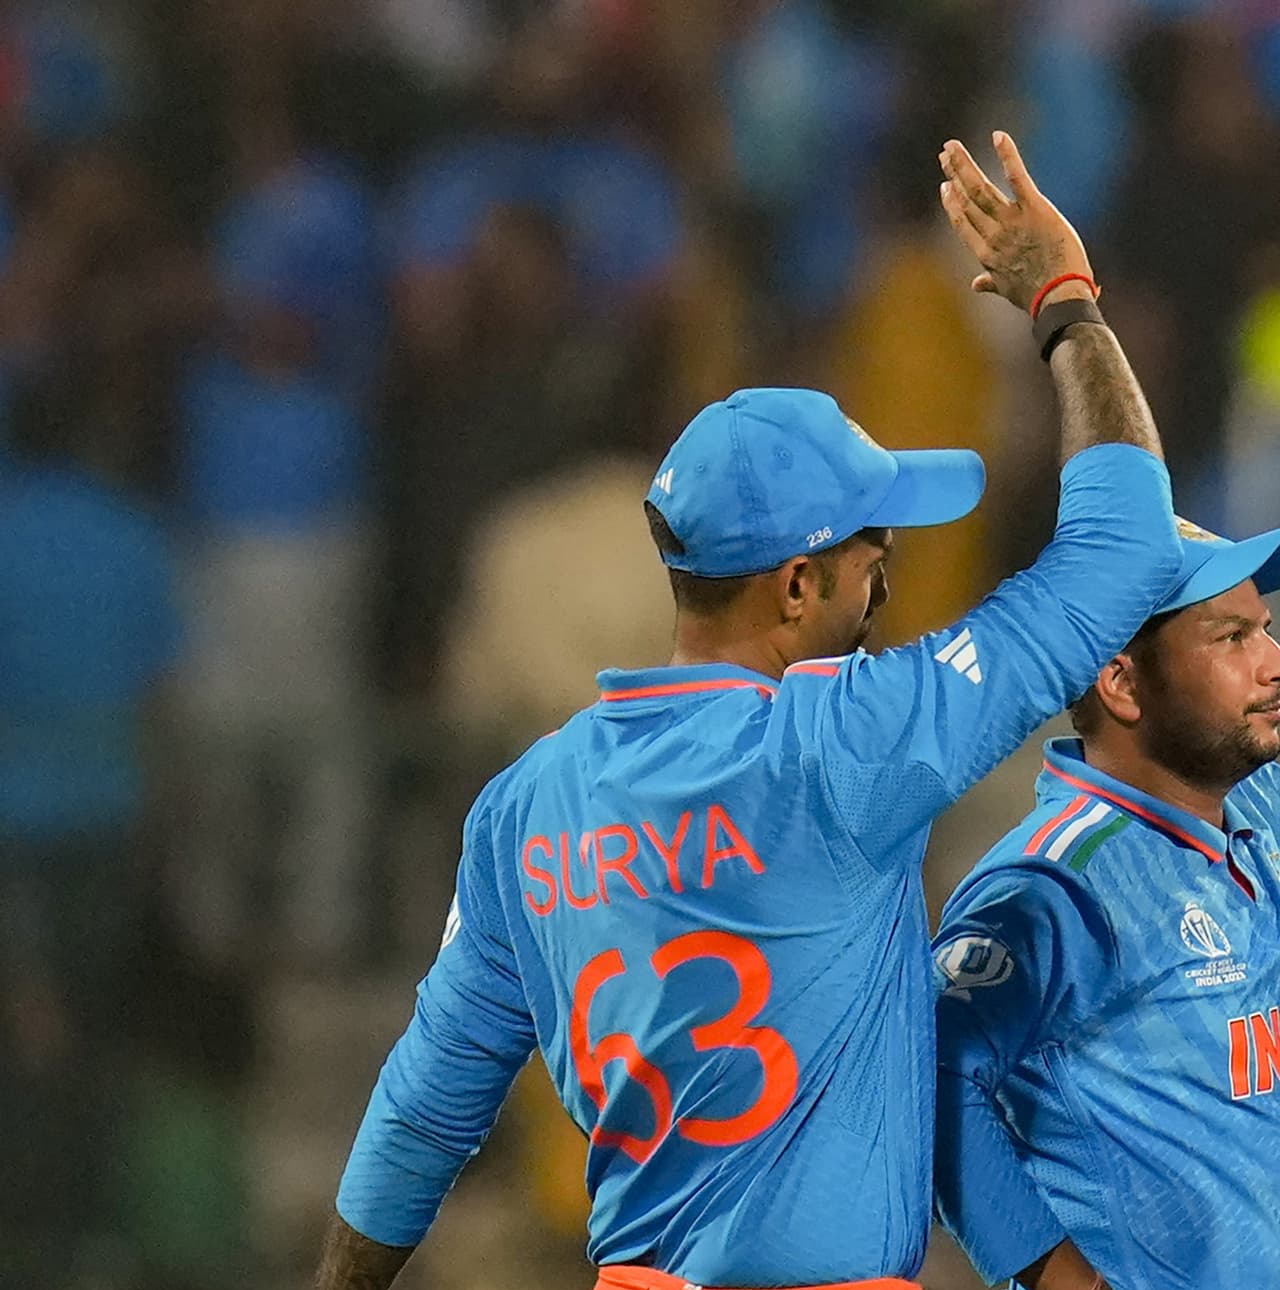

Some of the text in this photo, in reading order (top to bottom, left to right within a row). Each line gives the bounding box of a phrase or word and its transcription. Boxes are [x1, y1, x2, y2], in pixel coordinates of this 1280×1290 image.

[806, 526, 832, 548] 236
[522, 804, 766, 917] SURYA
[570, 930, 799, 1165] 63
